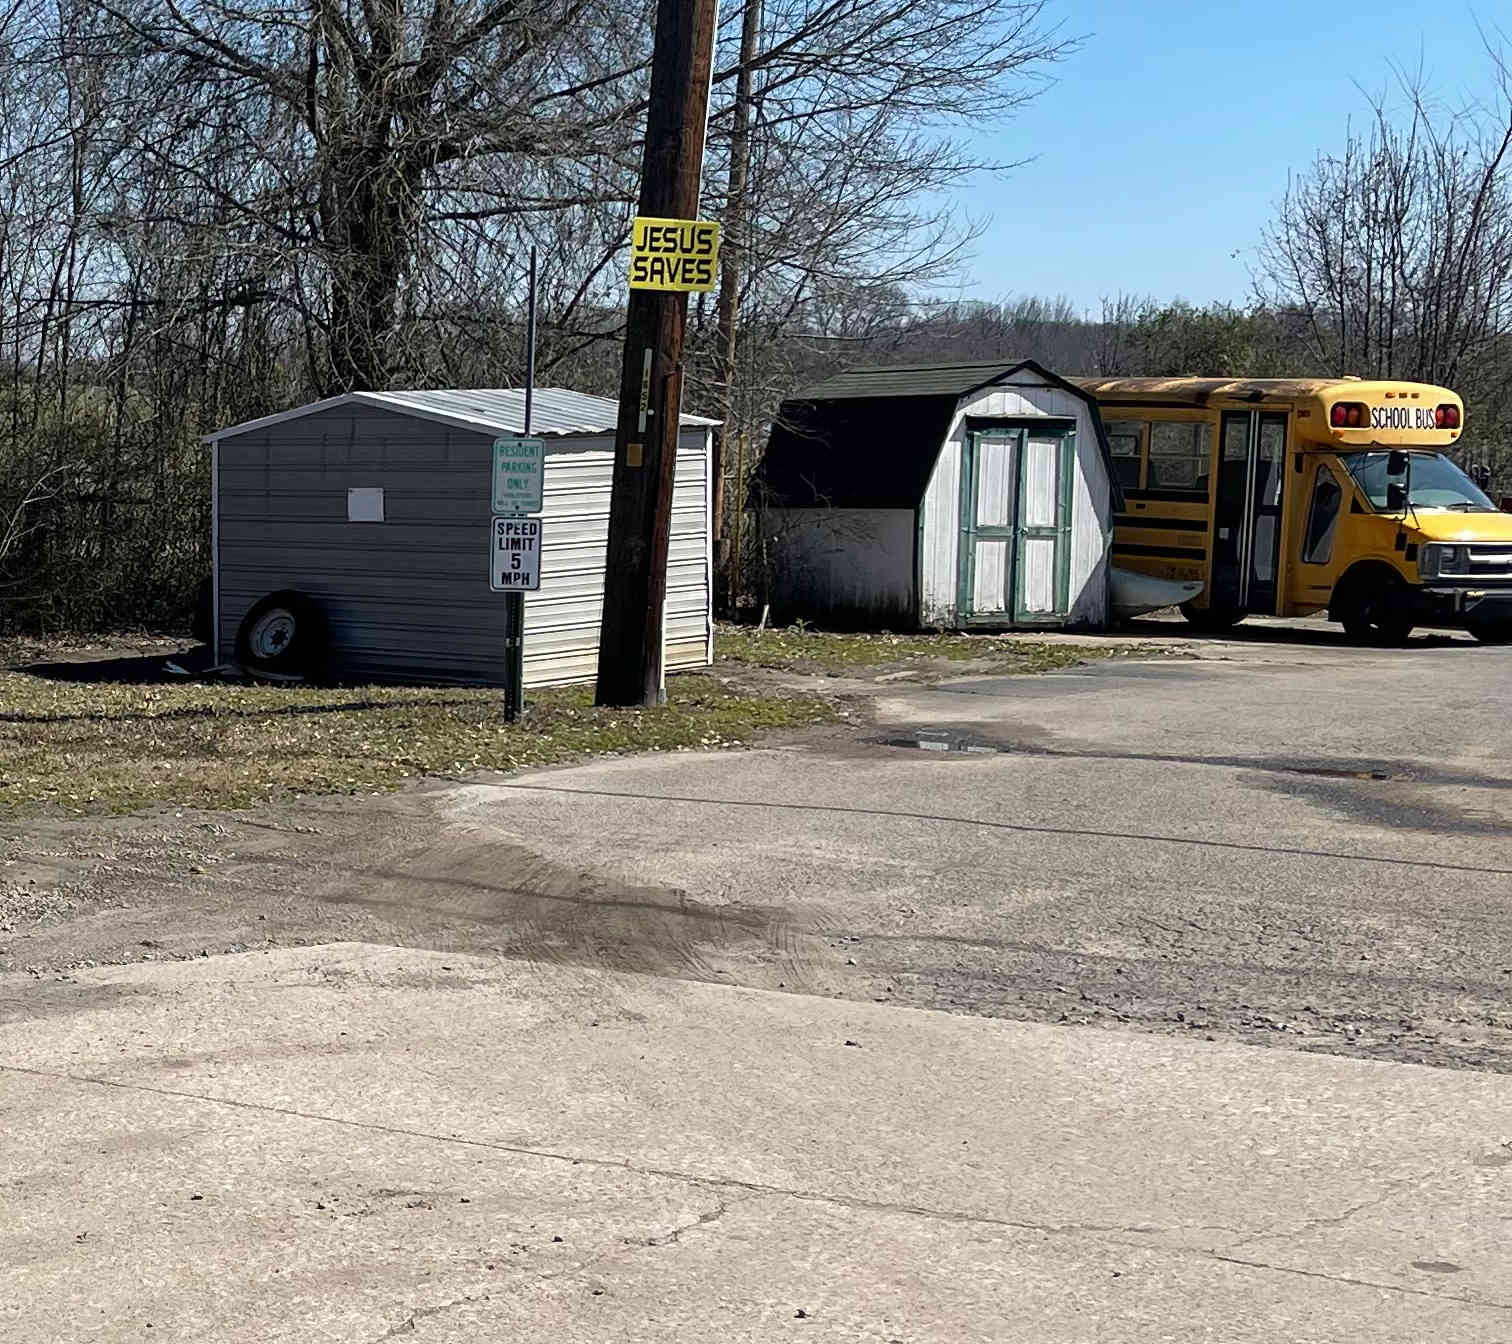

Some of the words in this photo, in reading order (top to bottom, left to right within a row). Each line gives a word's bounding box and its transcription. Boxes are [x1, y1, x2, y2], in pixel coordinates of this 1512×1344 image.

[636, 224, 713, 254] JESUS
[632, 256, 713, 286] SAVES
[1371, 407, 1413, 429] SCHOOL
[1415, 408, 1435, 429] BUS
[501, 462, 537, 473] PARKING
[507, 478, 529, 489] ONLY
[497, 522, 537, 536] SPEED
[498, 537, 535, 551] LIMIT
[511, 552, 521, 570] 5
[501, 572, 530, 586] MPH
